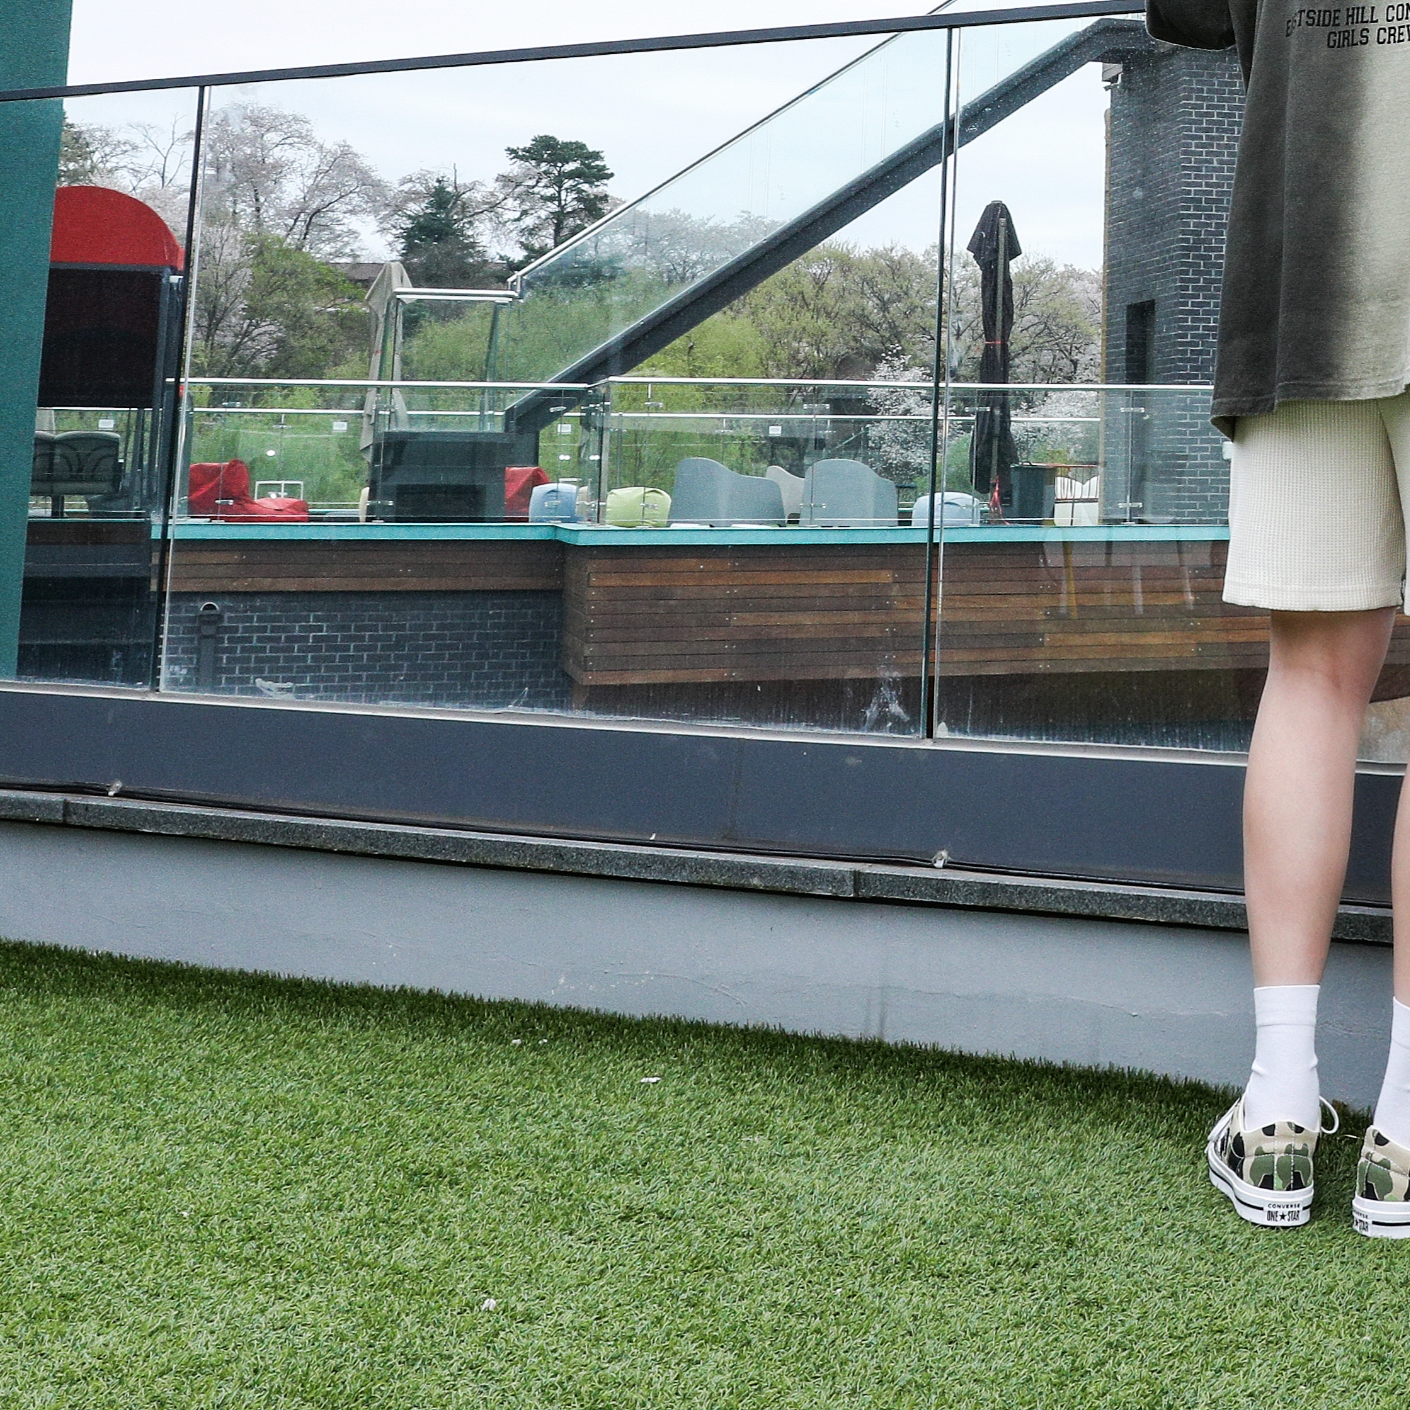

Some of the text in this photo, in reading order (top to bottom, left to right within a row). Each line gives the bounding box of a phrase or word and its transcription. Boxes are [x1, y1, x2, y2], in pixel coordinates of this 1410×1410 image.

[1285, 8, 1342, 38] ETSIDE
[1345, 6, 1379, 25] HILL
[1326, 27, 1370, 49] GIRLS
[1266, 1210, 1300, 1221] ONE STAR
